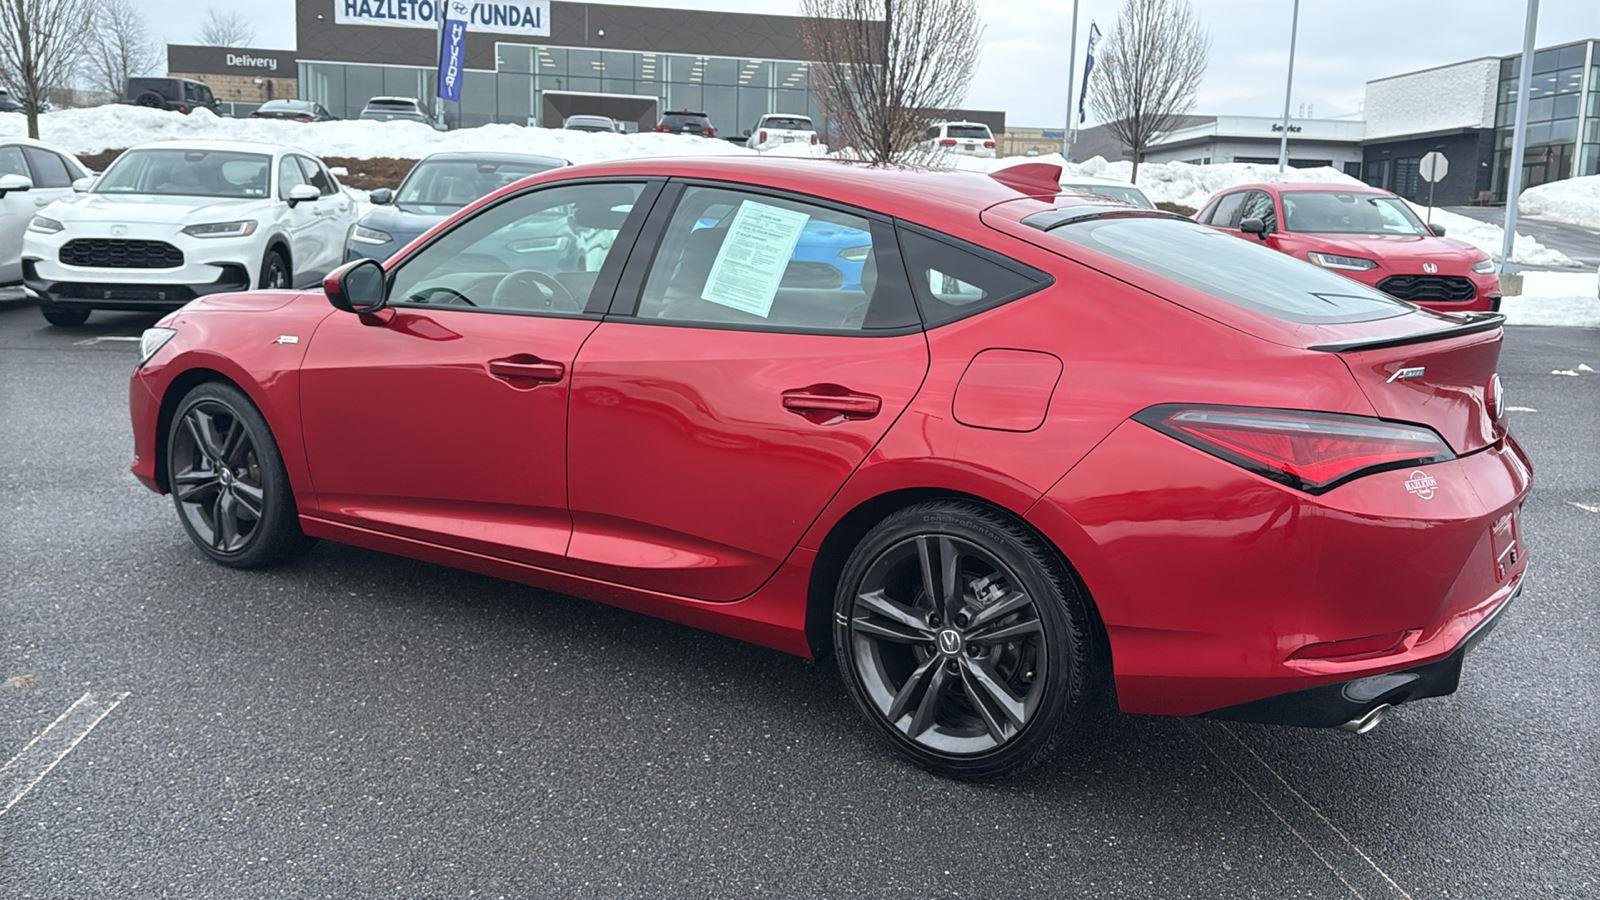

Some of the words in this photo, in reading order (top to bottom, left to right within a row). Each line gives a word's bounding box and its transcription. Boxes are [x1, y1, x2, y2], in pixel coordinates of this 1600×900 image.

[471, 2, 541, 28] YUNDAI
[226, 54, 278, 70] Delivery
[445, 23, 463, 97] HYUNDAI
[1271, 123, 1302, 133] Sevice
